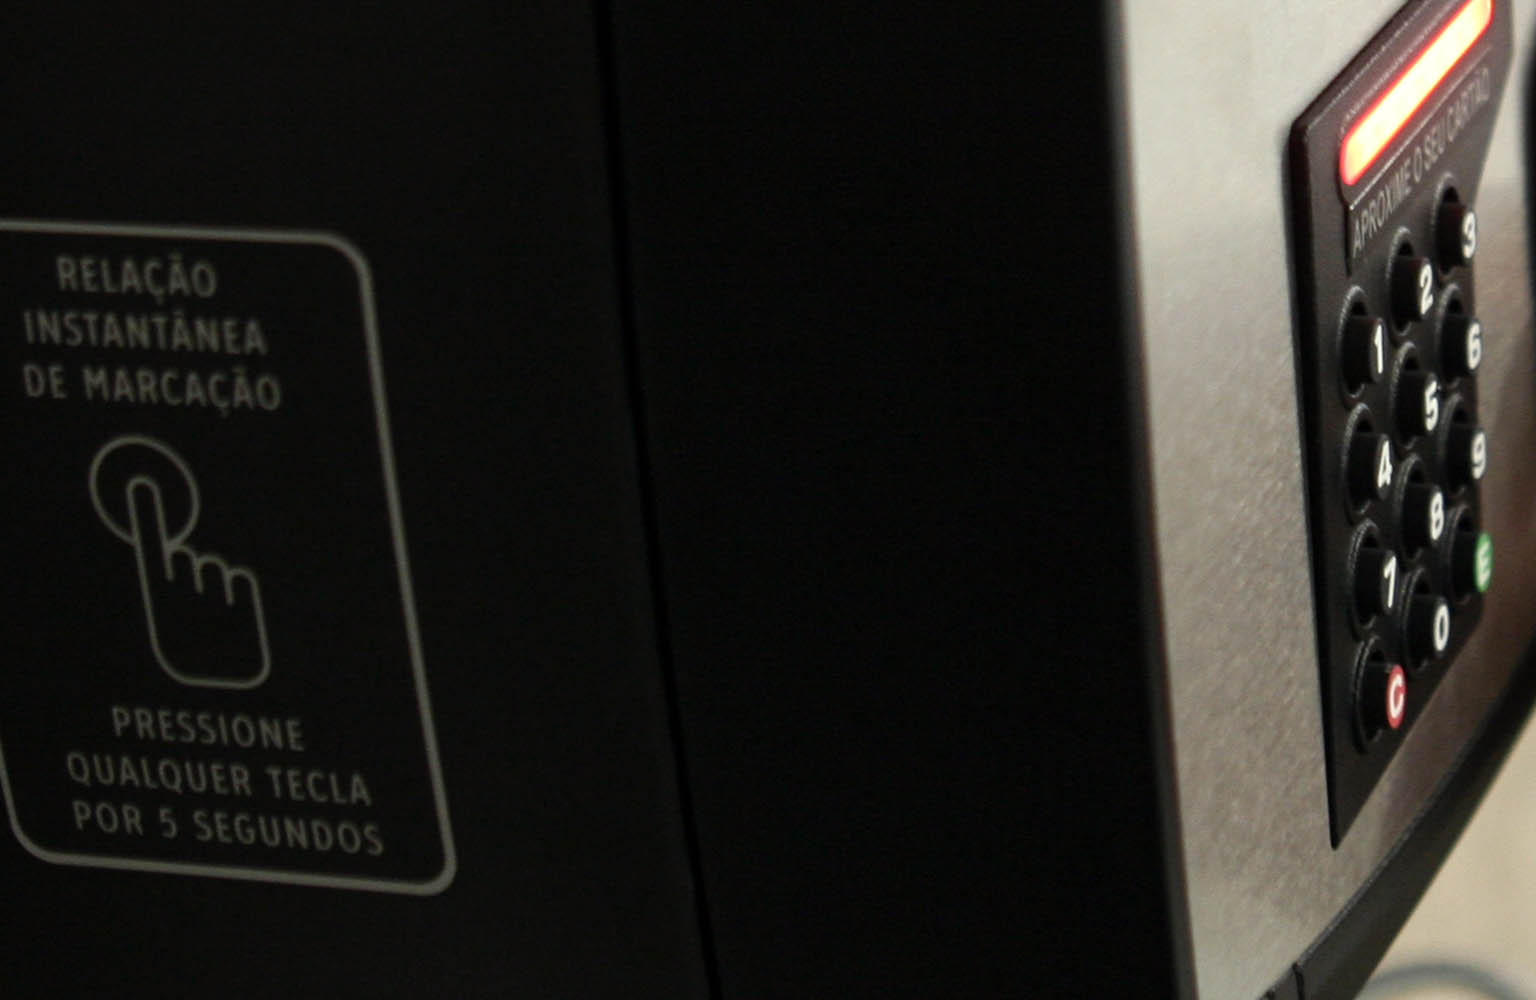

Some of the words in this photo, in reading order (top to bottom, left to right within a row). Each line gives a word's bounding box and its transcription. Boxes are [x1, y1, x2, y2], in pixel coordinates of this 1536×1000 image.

[1352, 156, 1412, 258] APROXIME
[1412, 145, 1423, 184] O
[1424, 119, 1445, 171] SEU
[1462, 211, 1476, 259] 3
[56, 253, 217, 303] RELAÇÃO
[1419, 265, 1433, 314] 2
[24, 309, 267, 356] INSTANTÂNEA
[1374, 325, 1384, 373] 1
[1467, 322, 1481, 369] 6
[22, 363, 67, 399] DE
[83, 367, 281, 417] MARCAÇÃO
[1425, 380, 1438, 430] 5
[1377, 441, 1392, 489] 4
[1471, 431, 1485, 478] 9
[1430, 491, 1444, 539] 8
[1476, 541, 1490, 584] E
[112, 706, 305, 751] PRESSIONE
[66, 751, 252, 796] QUALQUER
[267, 766, 372, 806] TECLA
[72, 799, 145, 836] POR
[159, 808, 178, 838] 5
[194, 809, 385, 856] SEGUNDOS
